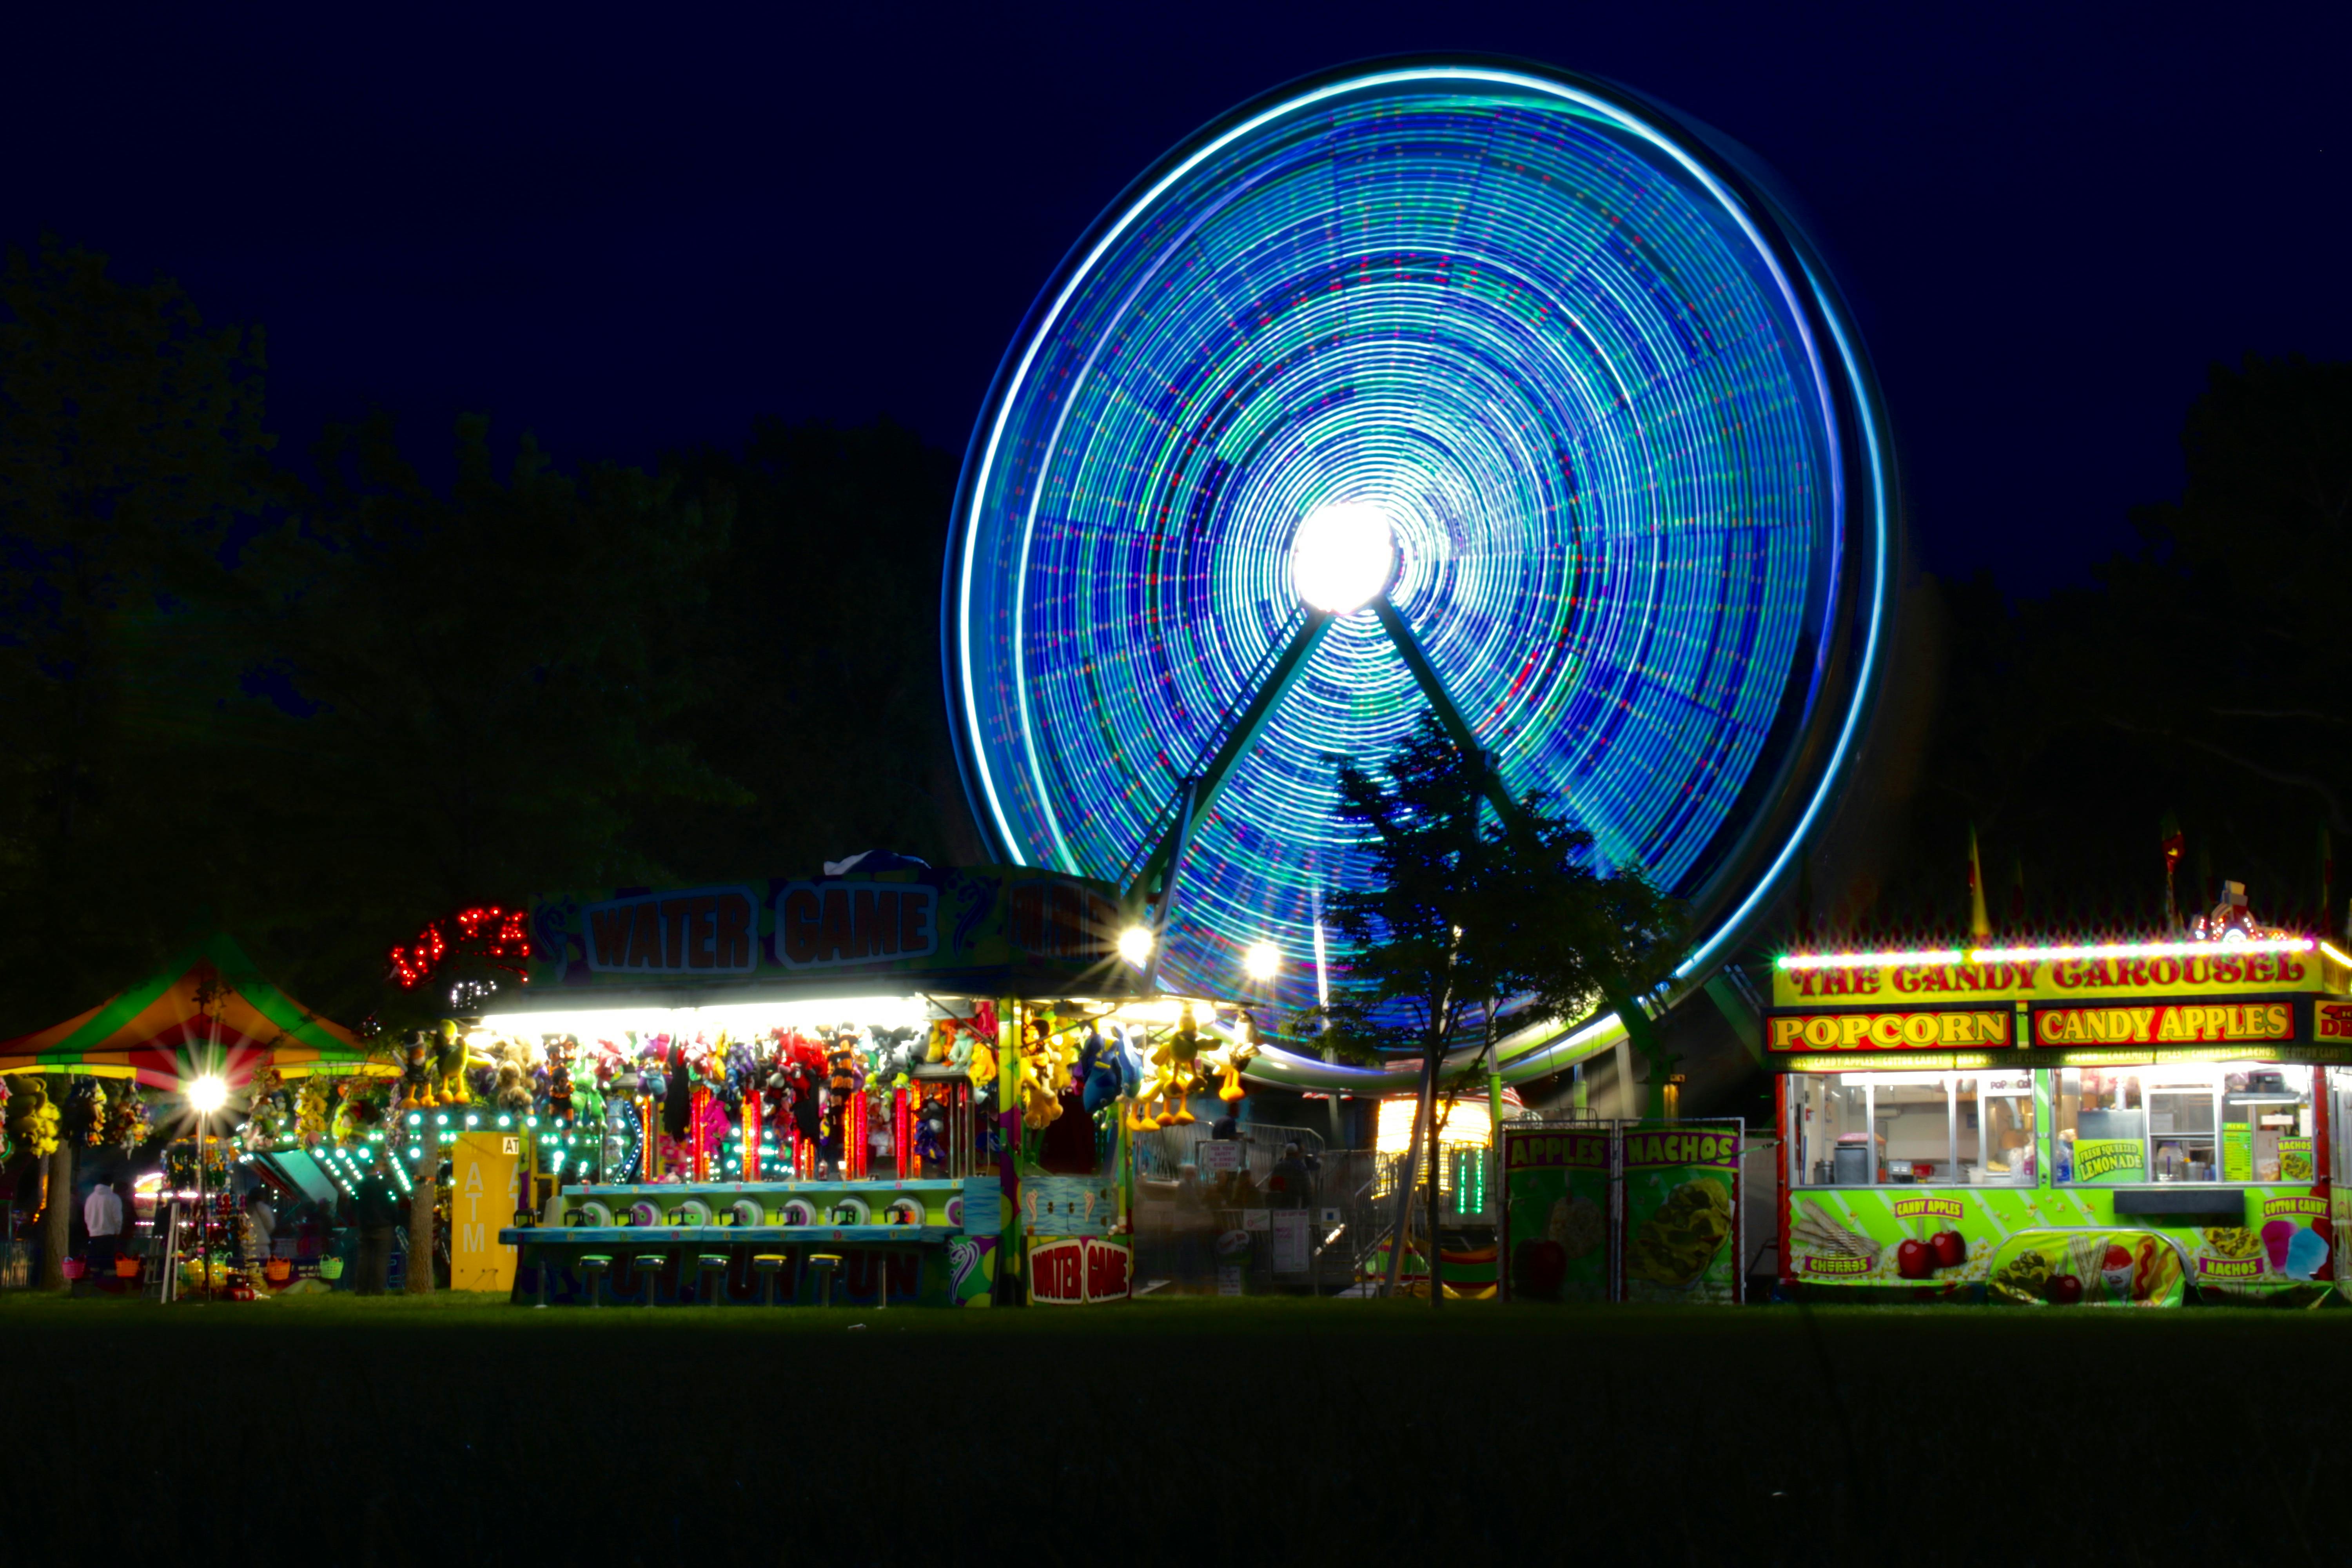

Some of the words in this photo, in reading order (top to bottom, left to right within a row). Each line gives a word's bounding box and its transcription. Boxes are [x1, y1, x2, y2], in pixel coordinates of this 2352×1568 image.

[591, 895, 750, 967] WATER
[785, 889, 928, 963] GAME
[1790, 964, 1881, 996] THE
[1893, 962, 2037, 993] CANDY
[2053, 955, 2305, 988] CAROUSEL
[1773, 1014, 2006, 1047] POPCORN
[2041, 1009, 2155, 1041] CANDY
[2159, 1005, 2288, 1038] APPLES
[1814, 1056, 1841, 1067] CANDY
[1844, 1056, 1875, 1067] APPLES
[1953, 1054, 1974, 1064] ORN
[1510, 1138, 1605, 1166] APPLES
[1628, 1135, 1734, 1166] NACHOS
[2080, 1146, 2102, 1163] FRESH
[2102, 1143, 2138, 1156] SQUEEZED
[2278, 1141, 2312, 1151] NACHOS
[2079, 1154, 2143, 1181] LEMONADE
[463, 1161, 485, 1253] ATM
[1896, 1201, 1924, 1216] CANDY
[1927, 1200, 1960, 1216] APPLES
[2265, 1199, 2296, 1215] COTTON
[2299, 1199, 2327, 1215] CANDY
[1032, 1246, 1081, 1299] WATER
[1088, 1246, 1127, 1298] GAME
[1810, 1258, 1867, 1273] CHURROS
[2206, 1260, 2257, 1276] NACHOS
